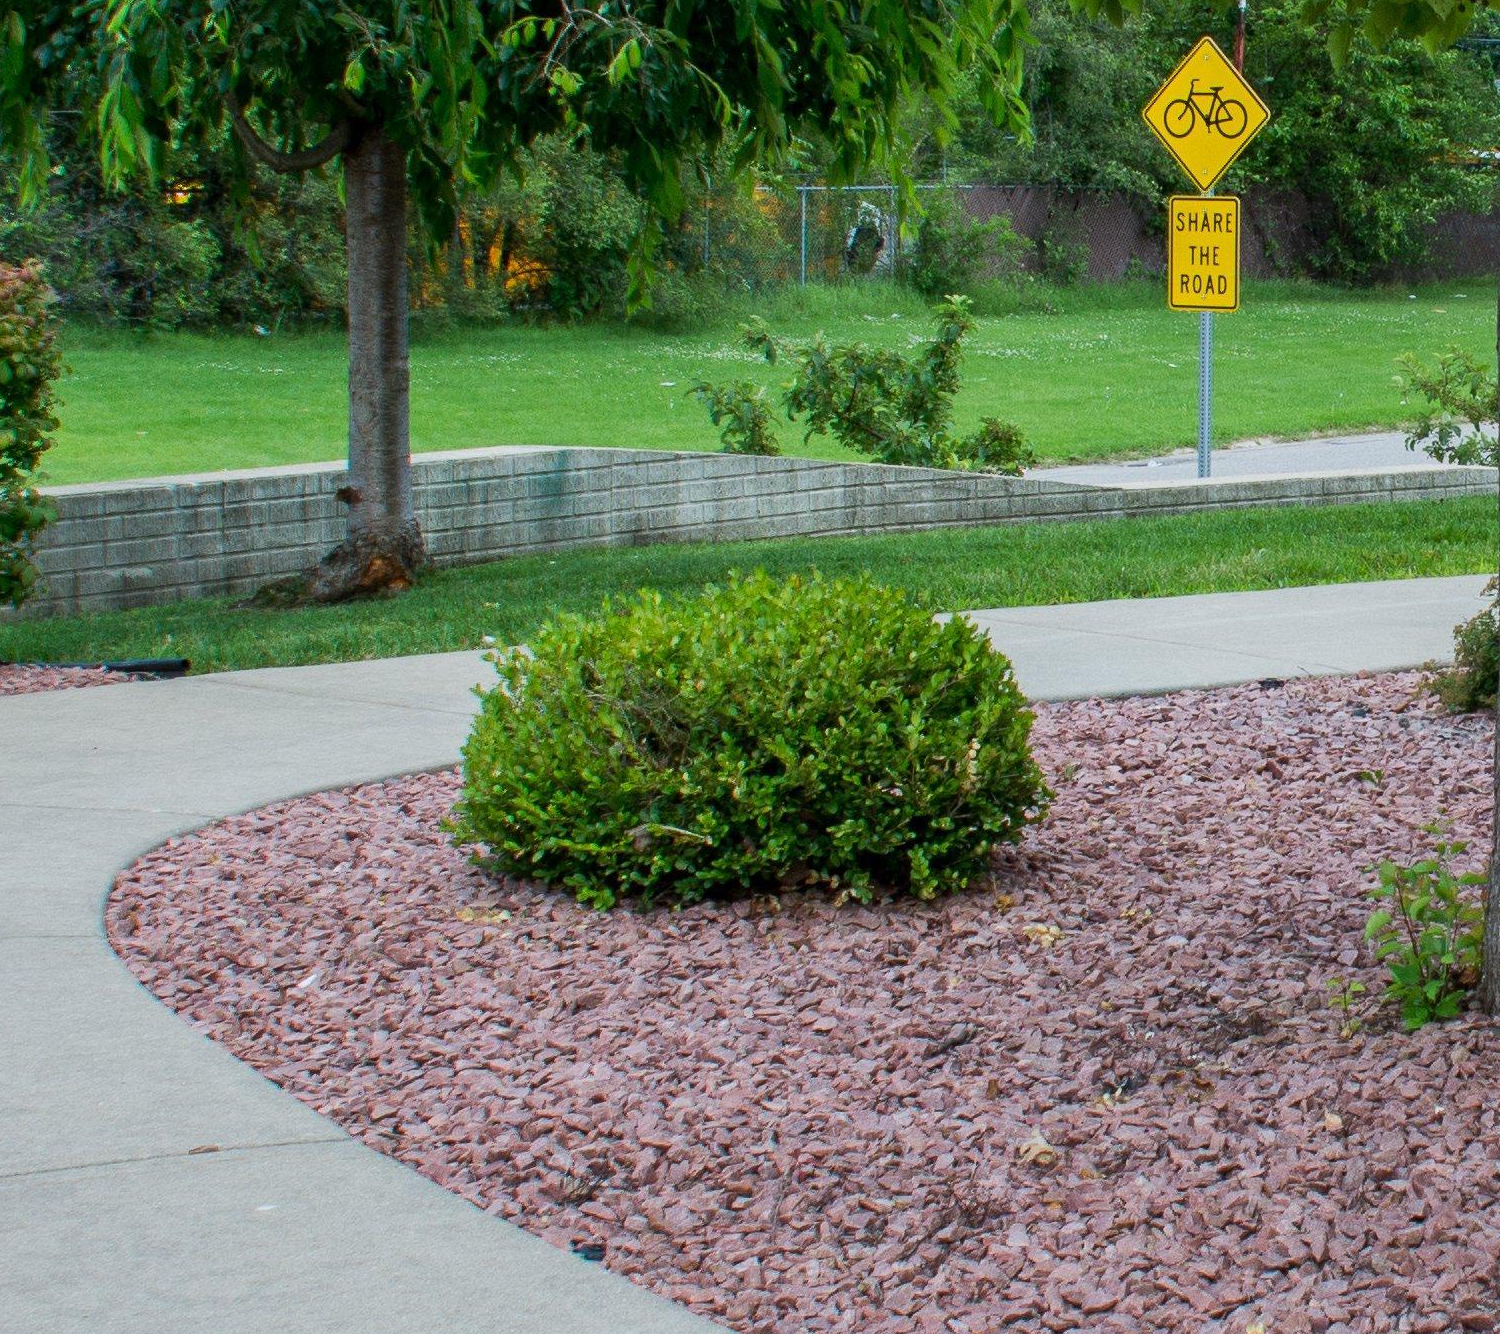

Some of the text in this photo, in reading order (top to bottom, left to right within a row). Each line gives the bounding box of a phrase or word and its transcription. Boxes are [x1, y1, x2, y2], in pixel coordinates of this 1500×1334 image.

[1175, 212, 1233, 233] SHARE
[1188, 245, 1220, 266] THE
[1180, 274, 1228, 295] ROAD
